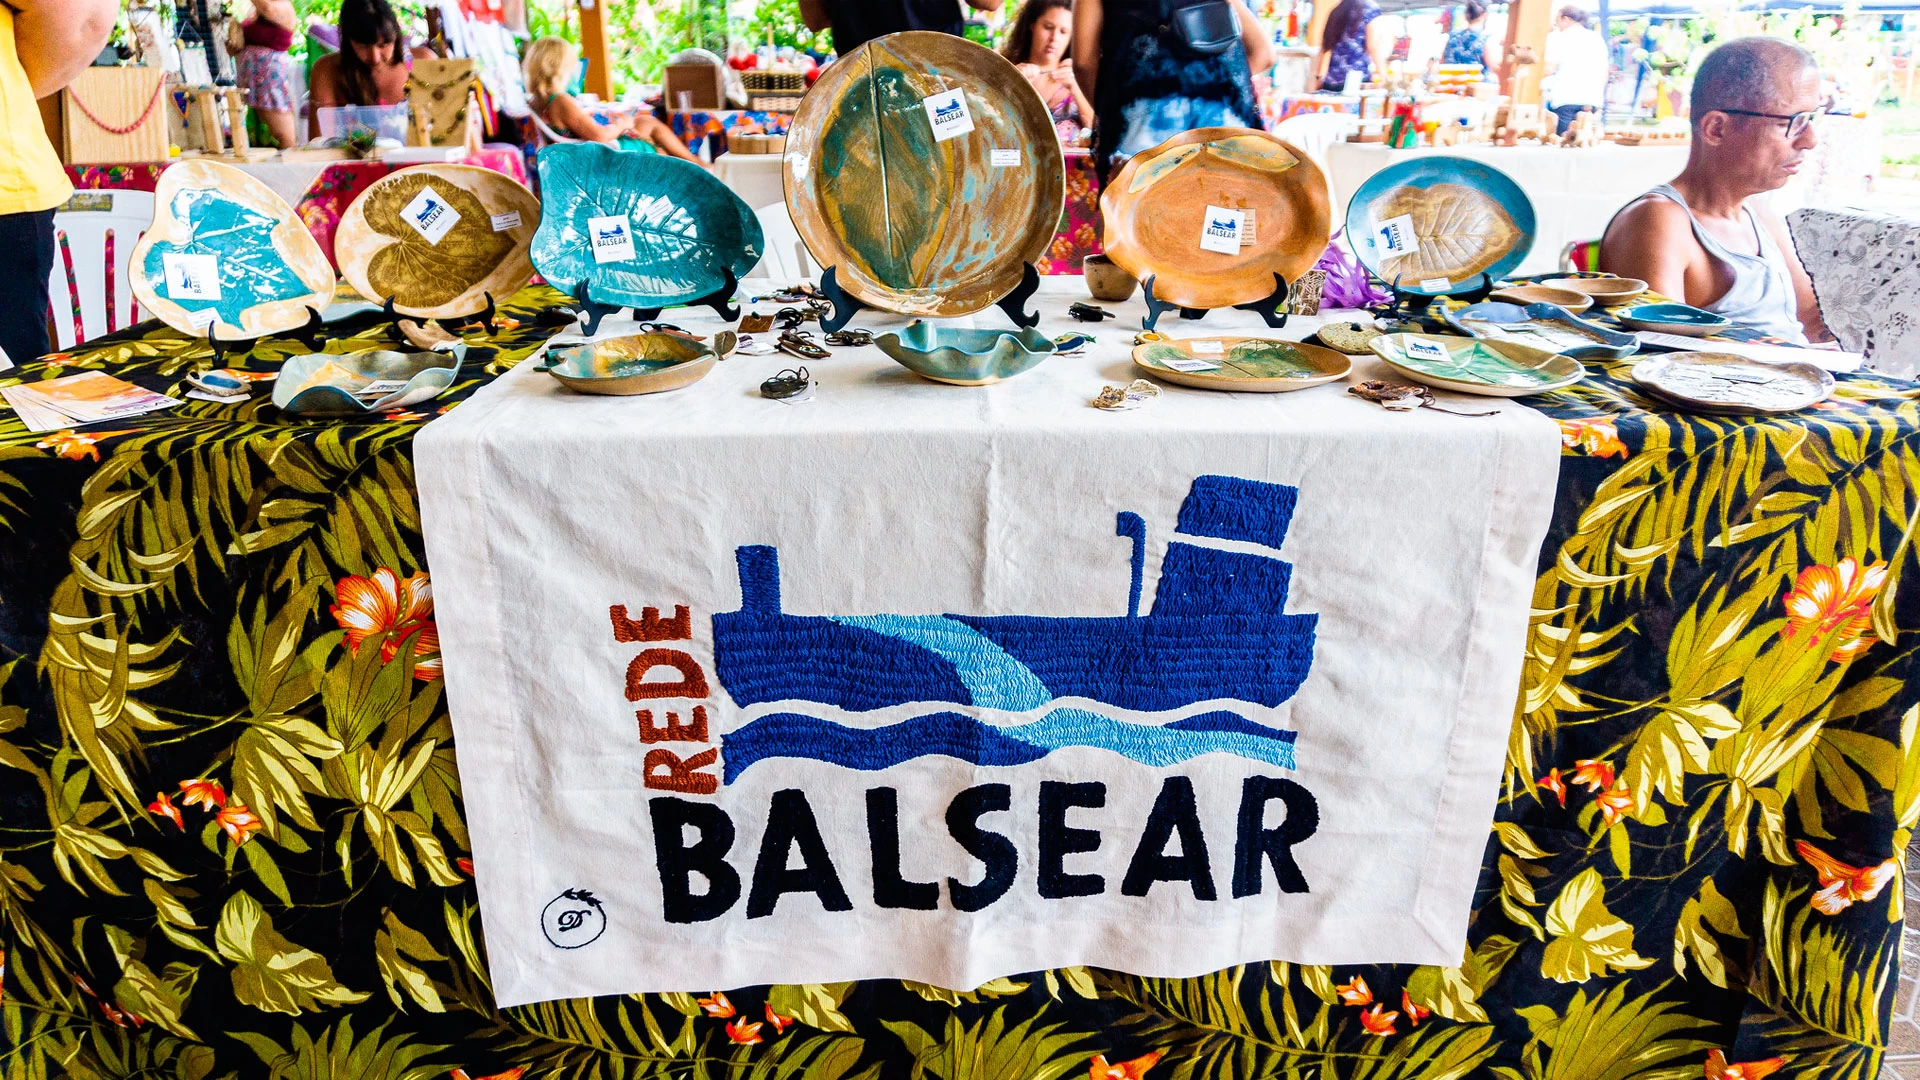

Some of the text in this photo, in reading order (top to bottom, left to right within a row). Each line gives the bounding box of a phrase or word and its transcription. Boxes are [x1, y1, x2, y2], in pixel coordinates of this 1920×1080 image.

[934, 110, 965, 126] BALSEAR
[420, 205, 446, 231] BALSEAR
[596, 237, 628, 248] BALSEAR
[1206, 227, 1237, 239] BALSEAR
[609, 604, 718, 795] REDE
[649, 774, 1320, 925] BALSEAR
